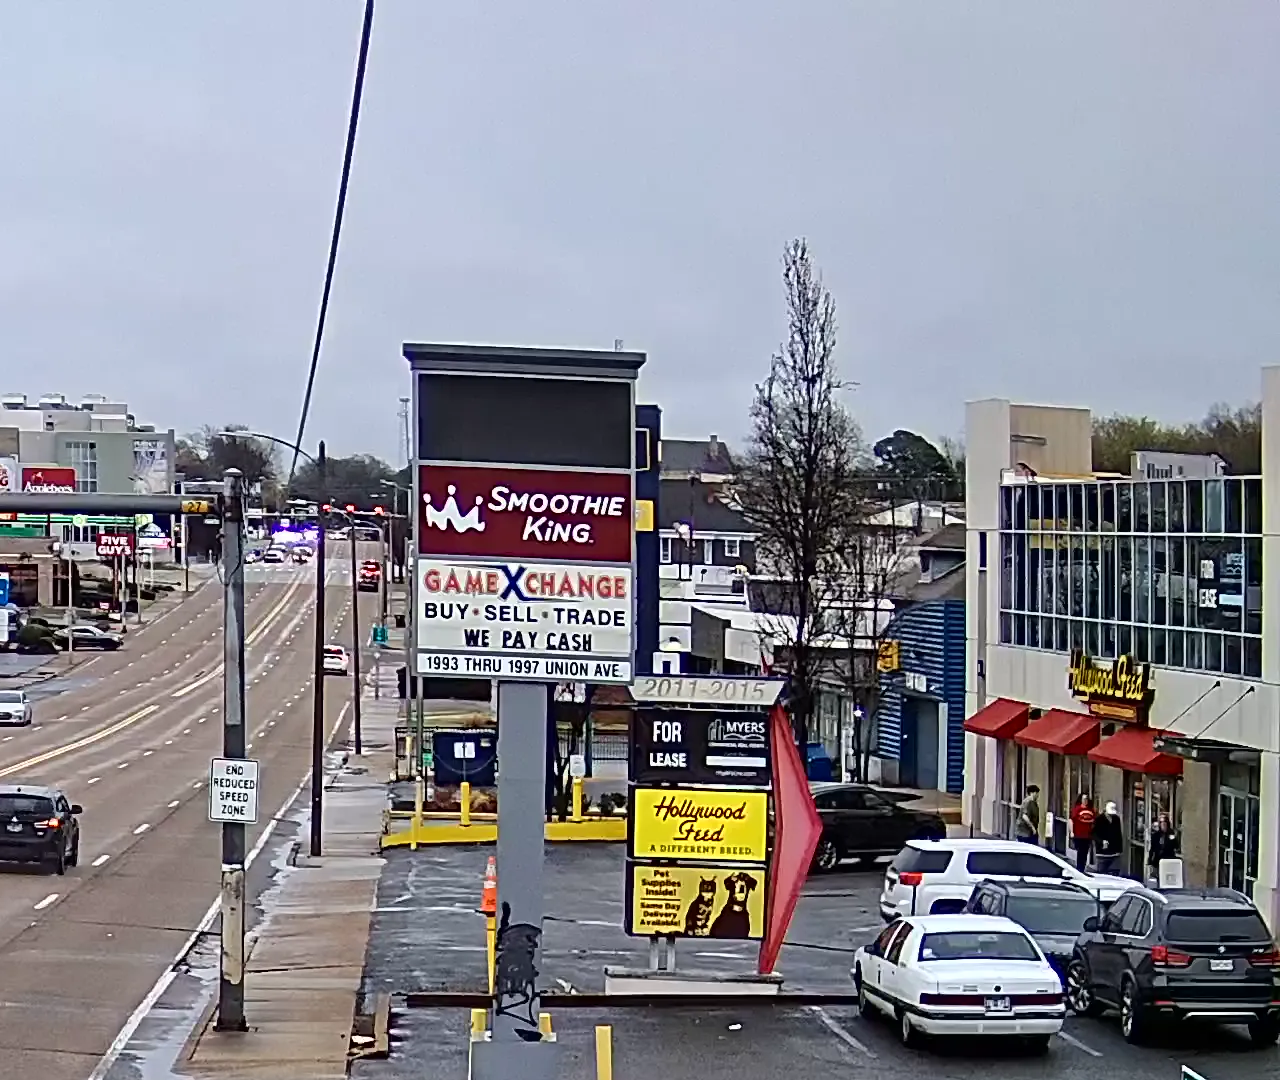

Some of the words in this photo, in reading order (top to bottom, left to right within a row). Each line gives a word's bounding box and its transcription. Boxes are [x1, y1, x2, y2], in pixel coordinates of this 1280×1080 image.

[187, 501, 202, 513] 27
[487, 485, 626, 517] SMOOTHIE
[100, 535, 128, 546] FIVE
[98, 545, 132, 556] GUYS
[424, 602, 469, 620] BUY
[484, 604, 538, 623] SELL
[553, 607, 626, 627] TRADE
[464, 628, 490, 648] WE
[502, 630, 538, 650] PAY
[546, 632, 592, 652] CASH
[426, 655, 459, 671] 1993
[464, 657, 502, 673] THRU
[509, 659, 540, 675] 1997
[545, 661, 589, 677] UNION
[594, 663, 624, 678] AVE.
[642, 678, 766, 700] 2011-2015
[653, 720, 682, 743] FOR
[726, 721, 766, 734] MYERS
[649, 752, 688, 768] LEASE
[225, 764, 244, 776] END
[213, 778, 256, 790] REDUCED
[219, 791, 249, 803] SPEED
[221, 804, 246, 817] ZONE
[653, 796, 747, 822] Hollywood
[673, 820, 725, 841] Feed
[649, 844, 656, 852] A
[659, 845, 716, 854] DIFFERENT
[653, 869, 670, 878] Pet
